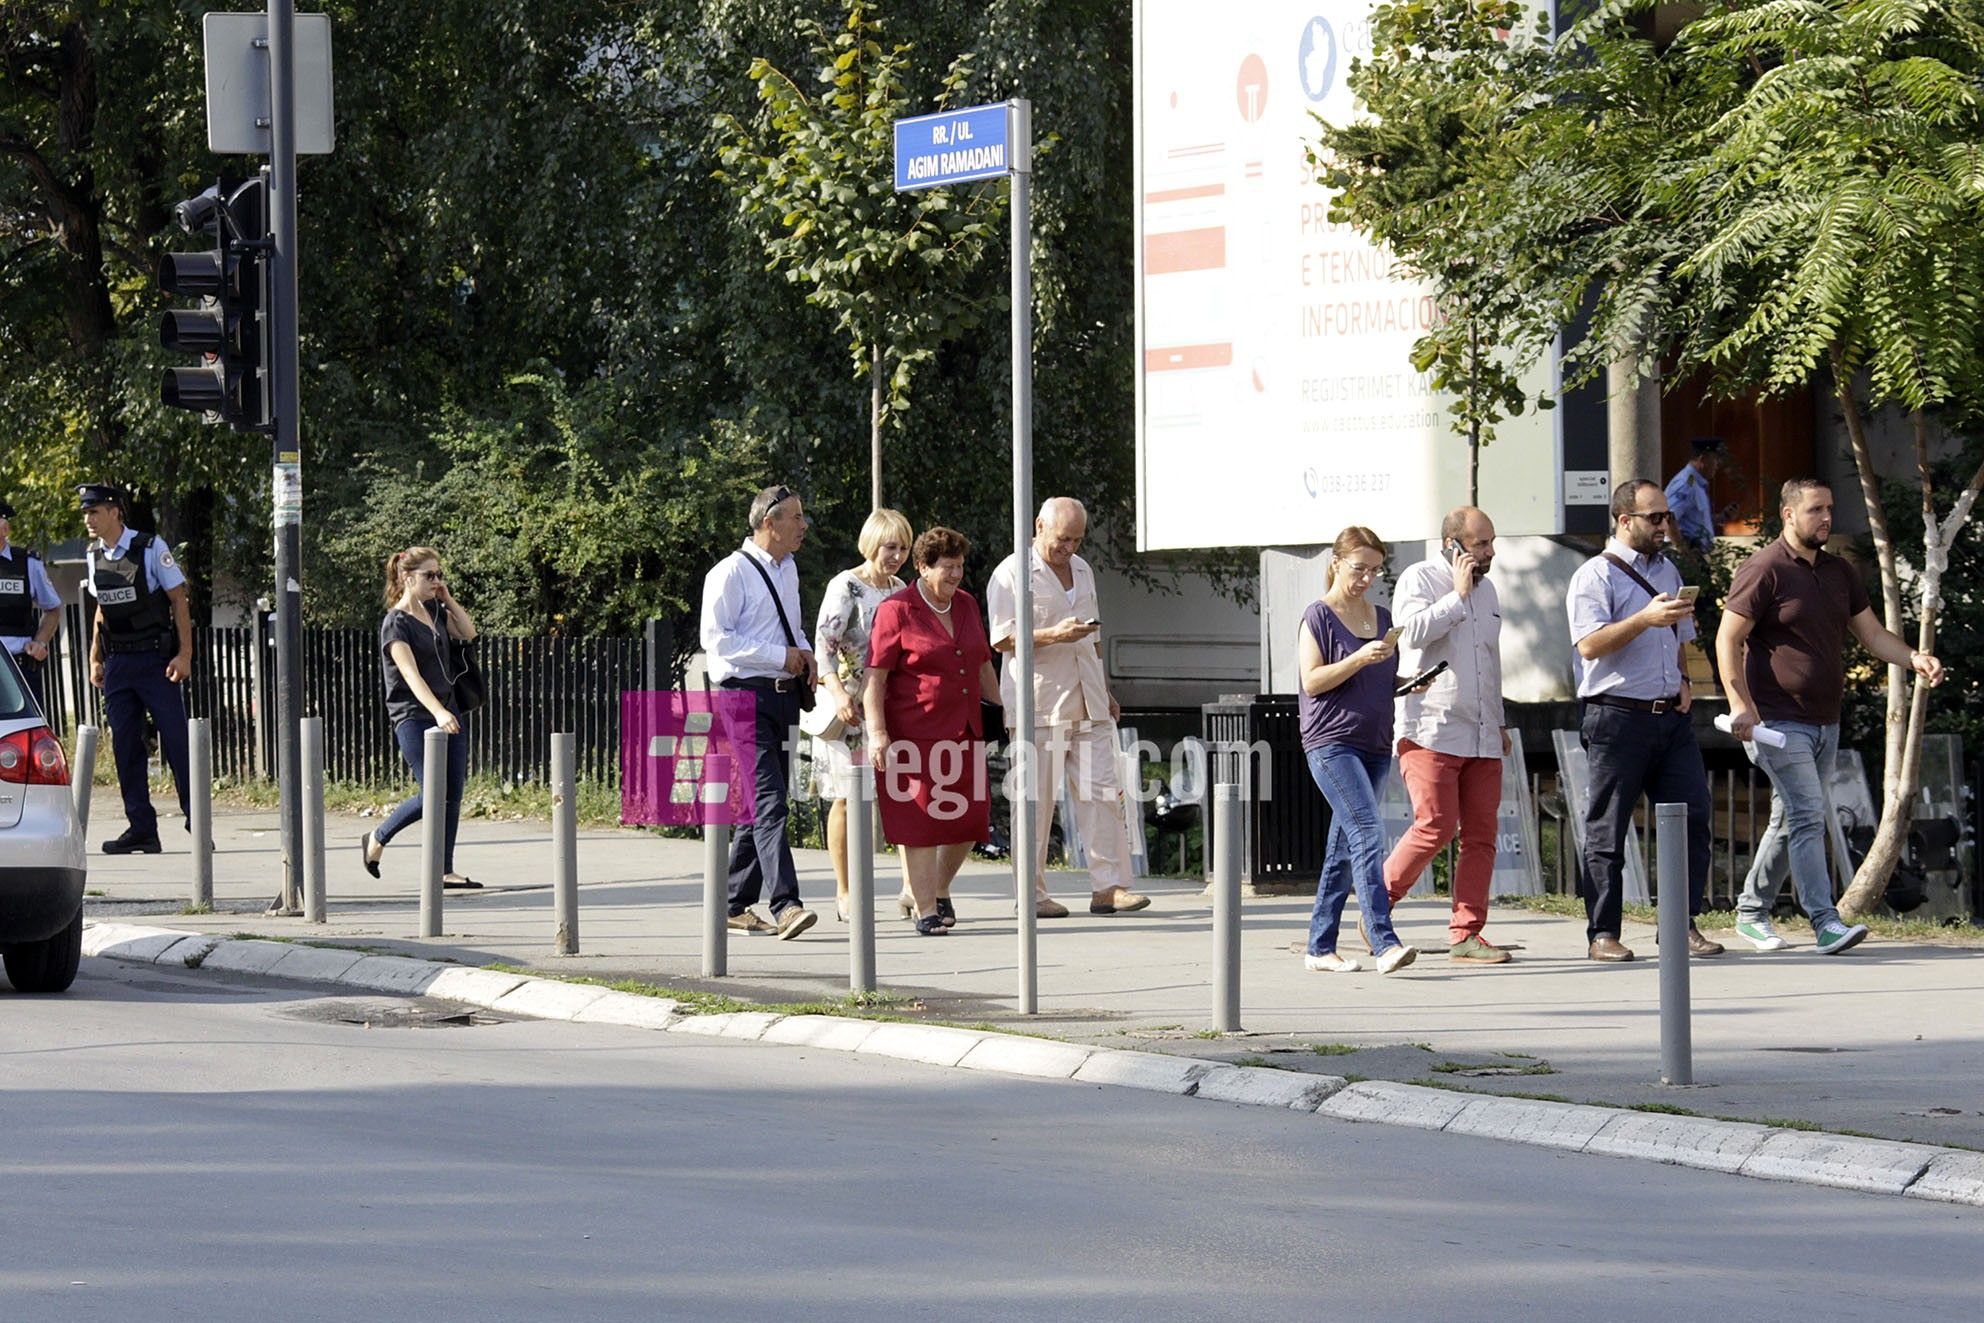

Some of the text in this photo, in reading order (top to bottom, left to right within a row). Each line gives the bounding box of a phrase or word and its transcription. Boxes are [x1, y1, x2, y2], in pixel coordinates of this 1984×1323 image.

[907, 143, 1004, 180] AGIM RAMADANI
[1301, 254, 1312, 286] E
[0, 580, 20, 592] ICE
[1496, 833, 1521, 852] ICE
